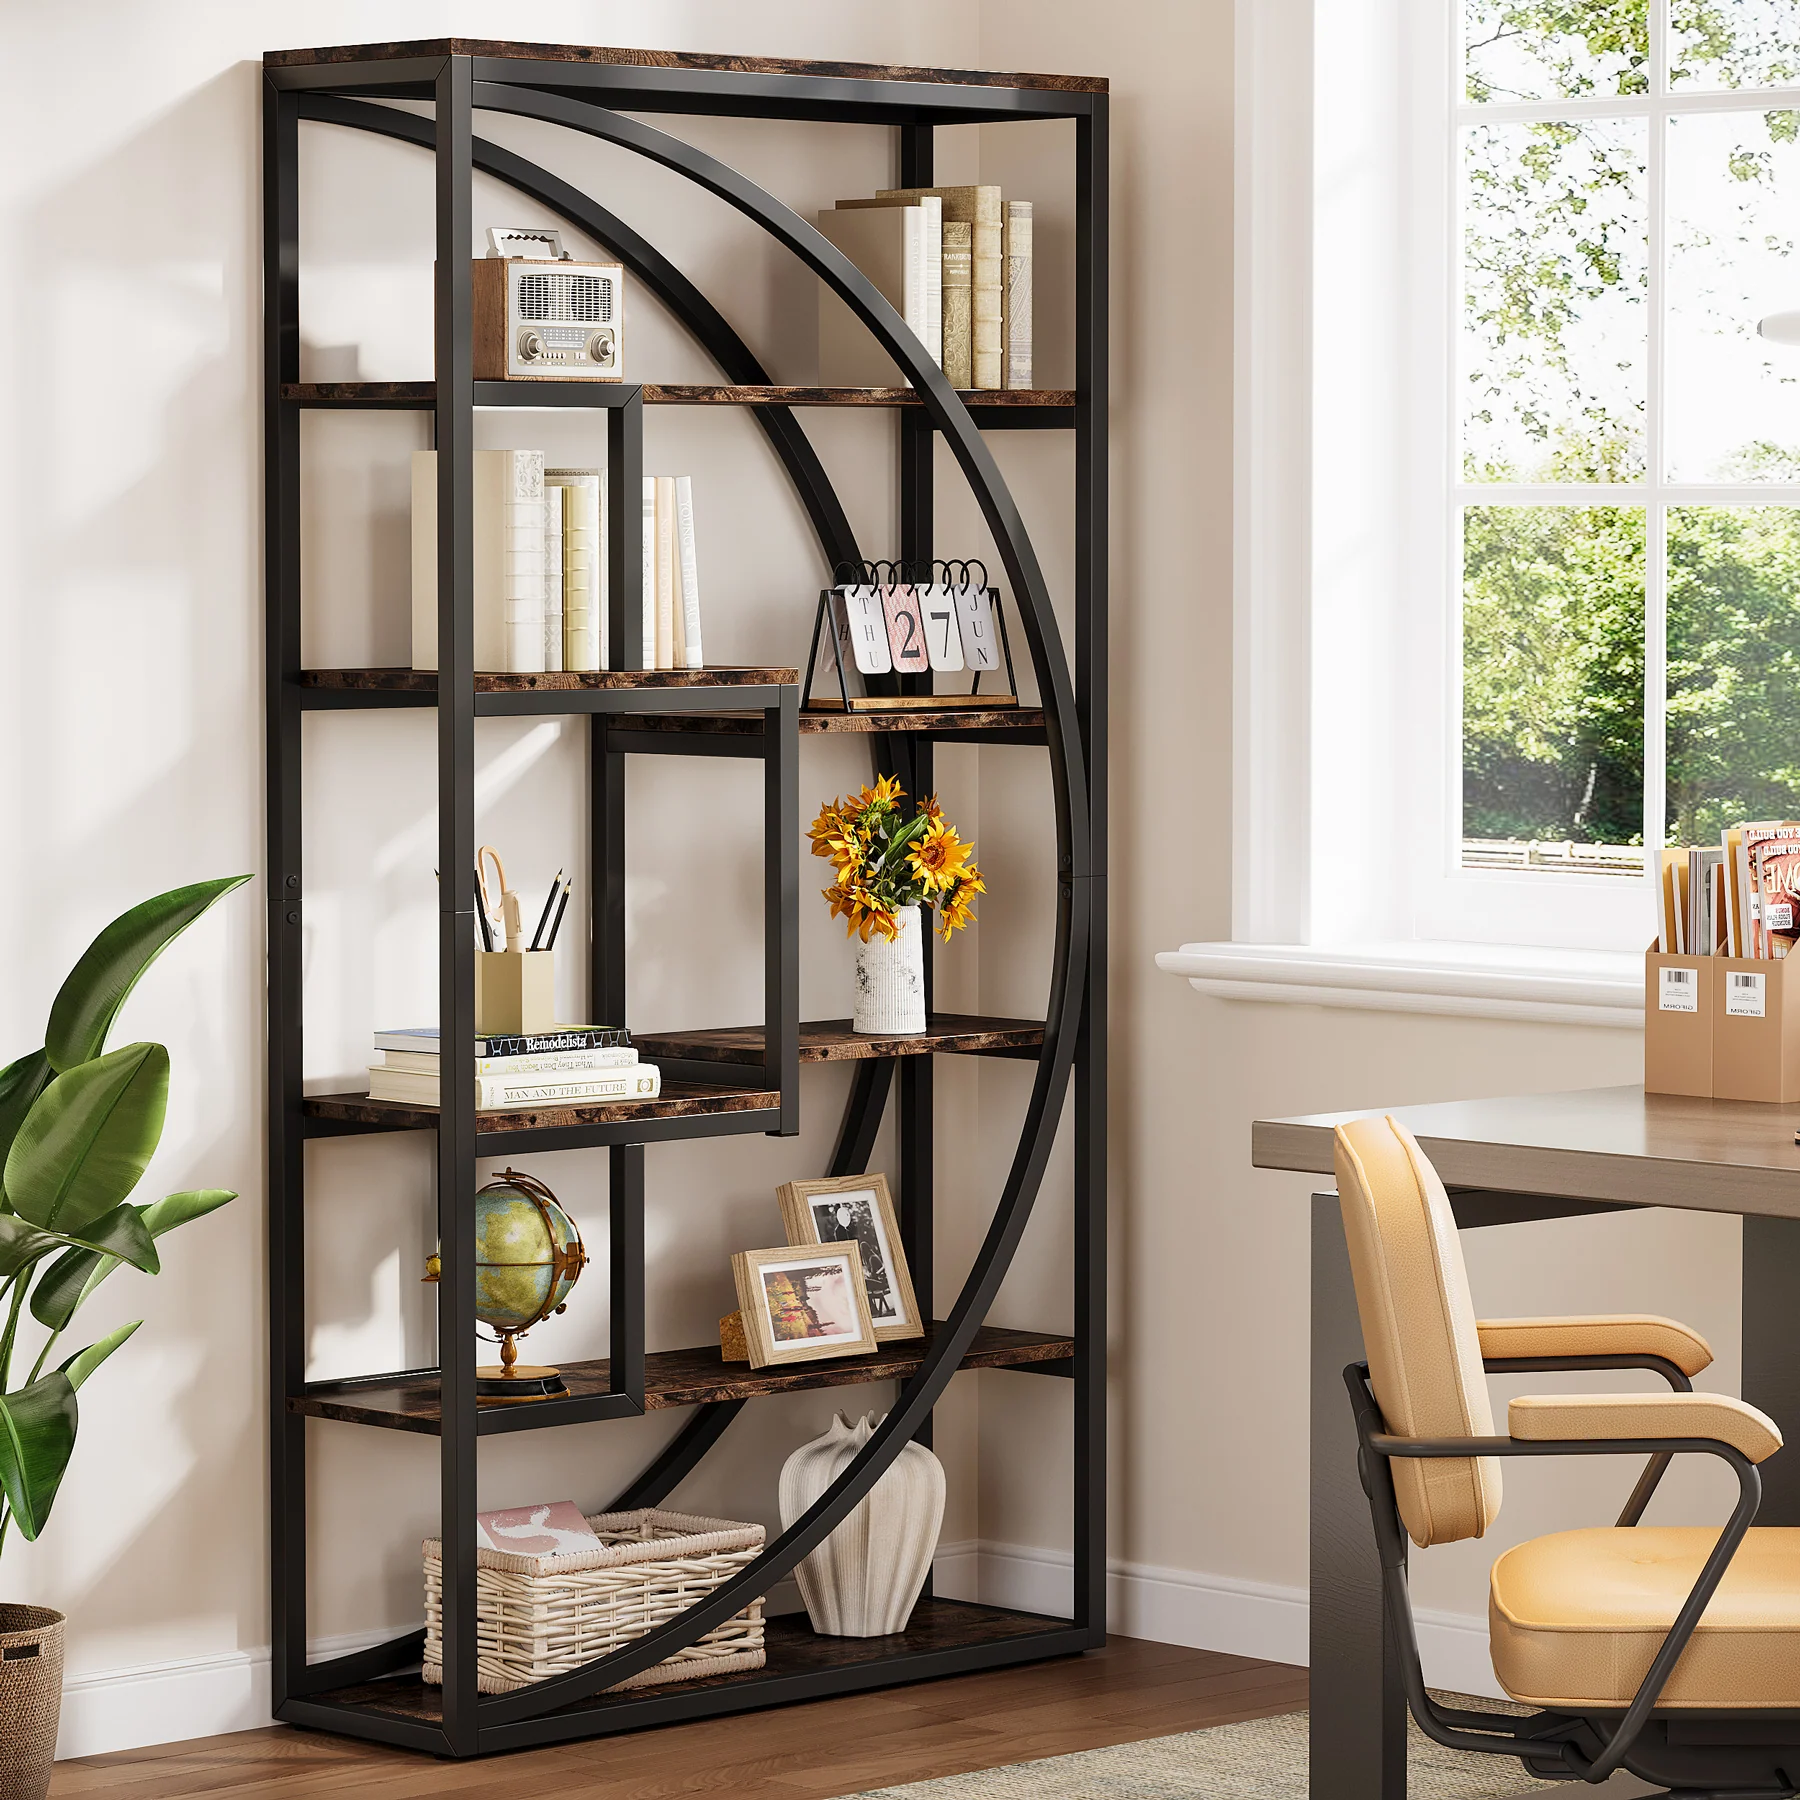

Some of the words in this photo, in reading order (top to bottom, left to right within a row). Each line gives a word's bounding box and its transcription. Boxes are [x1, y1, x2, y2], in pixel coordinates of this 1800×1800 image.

[679, 500, 693, 545] YOUNG
[685, 585, 699, 631] SHACK
[526, 1034, 587, 1051] Remodelista
[557, 1061, 574, 1070] They
[575, 1060, 593, 1069] What
[504, 1088, 529, 1100] MAN
[532, 1087, 556, 1098] AND
[558, 1085, 582, 1096] THE
[584, 1082, 627, 1095] FUTURE
